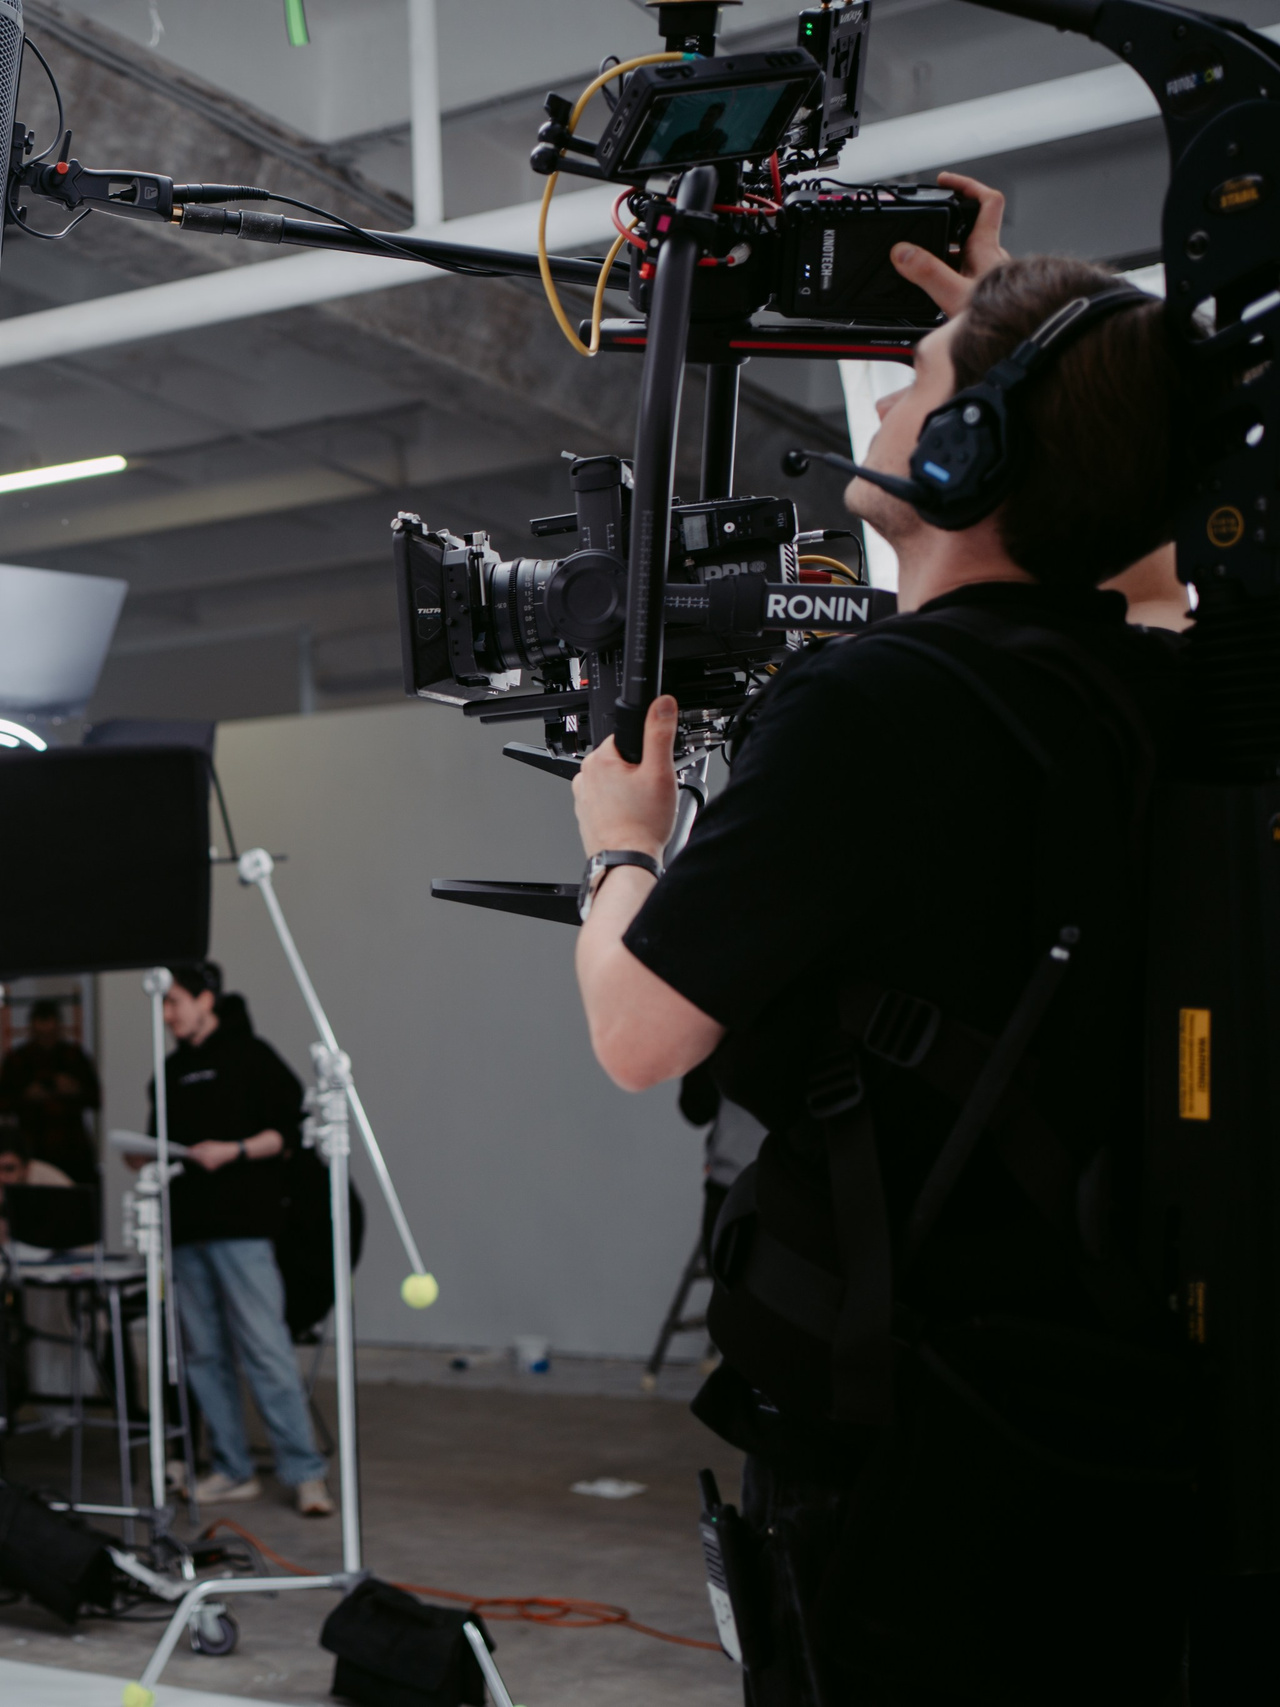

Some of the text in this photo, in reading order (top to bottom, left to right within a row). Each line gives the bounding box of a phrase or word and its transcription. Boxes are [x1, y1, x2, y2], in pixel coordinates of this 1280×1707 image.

[821, 229, 836, 276] KINOTECH
[537, 580, 546, 591] 24
[767, 593, 869, 622] RONIN
